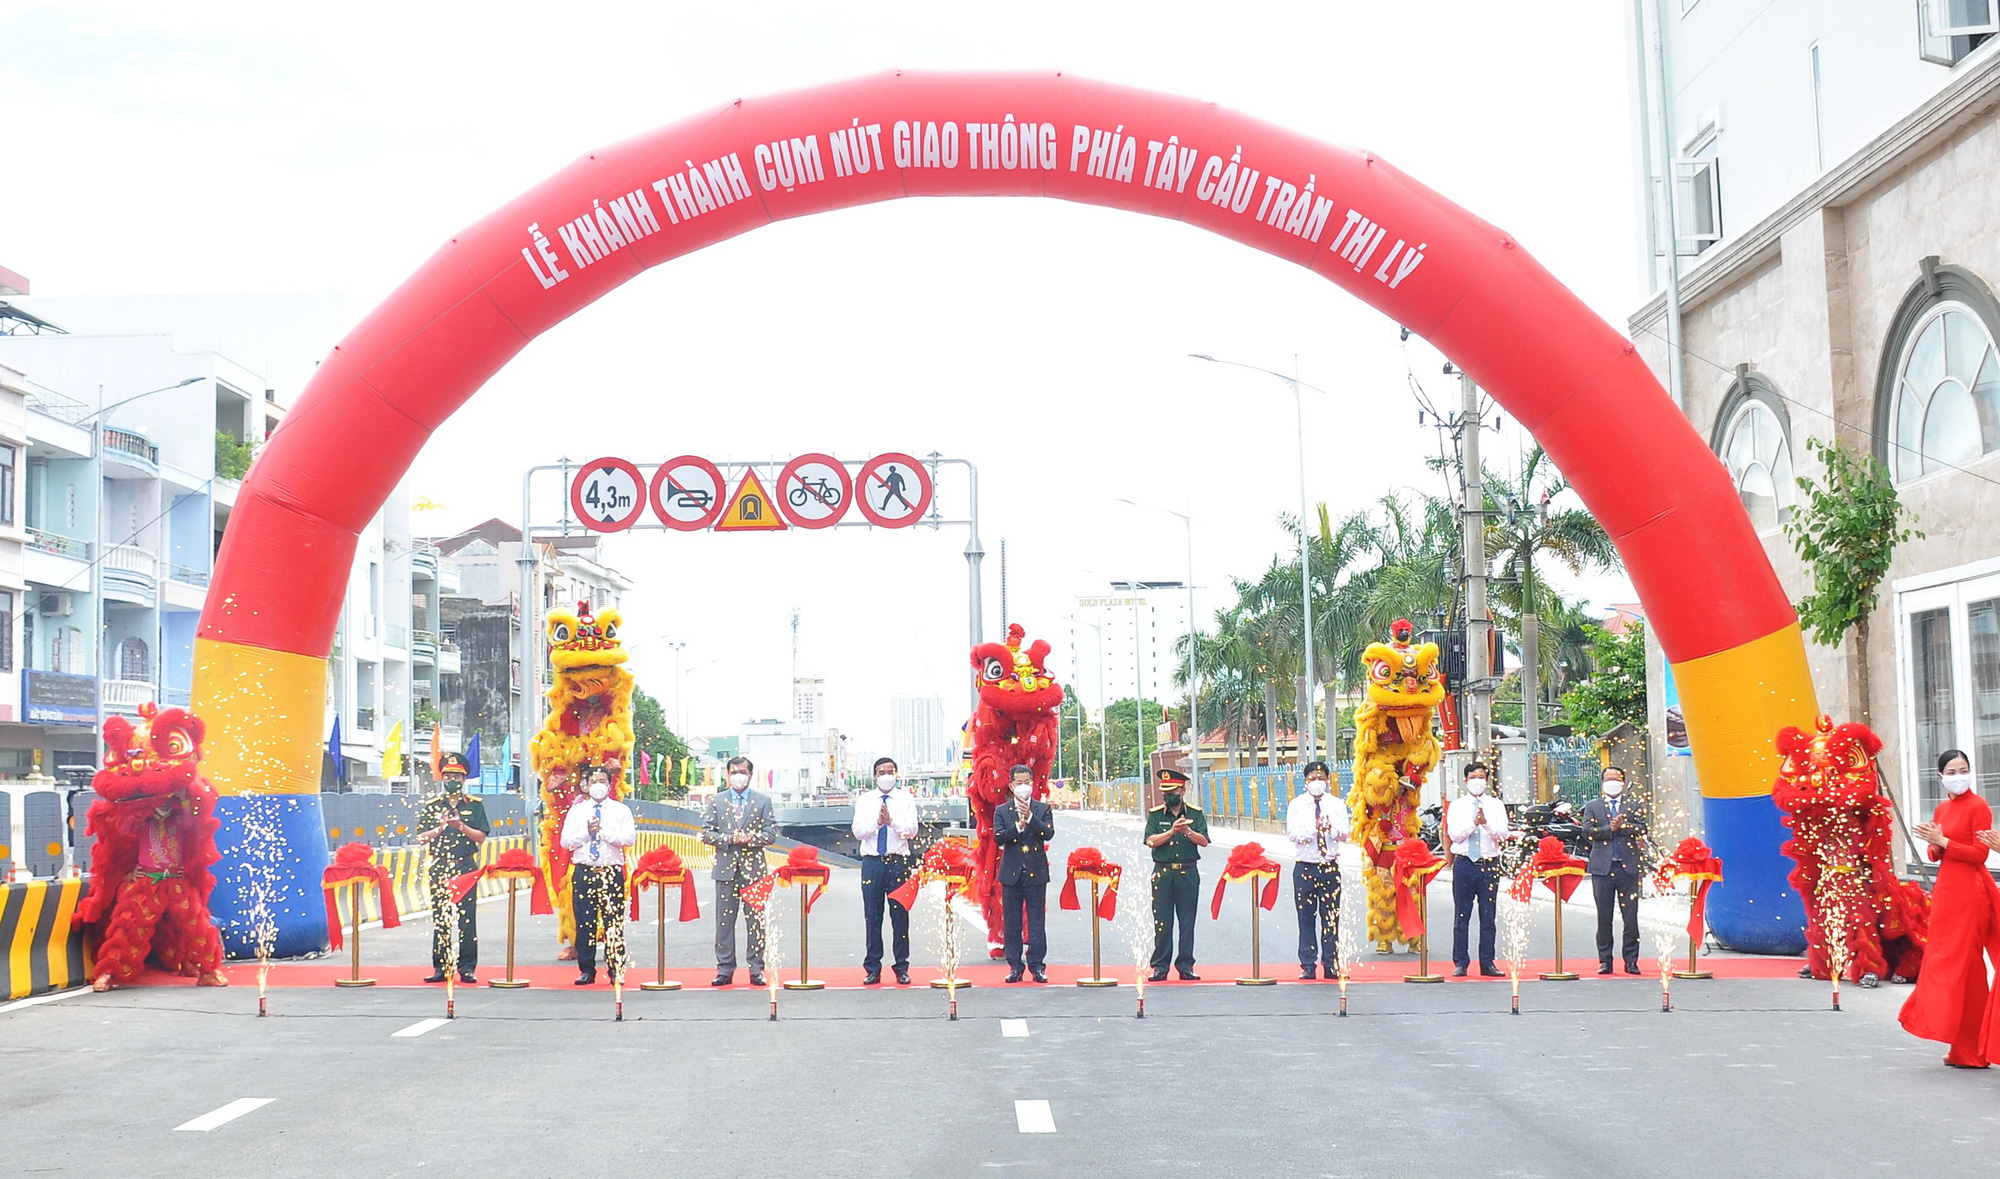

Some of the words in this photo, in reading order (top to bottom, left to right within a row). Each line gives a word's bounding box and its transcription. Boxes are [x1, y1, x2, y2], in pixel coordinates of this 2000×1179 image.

[521, 222, 570, 290] LỄ
[557, 198, 661, 269] KHÁNH
[652, 159, 752, 224] THÀNH
[754, 135, 825, 193] CỤM
[829, 117, 884, 178] NÚT
[893, 120, 959, 169] GIAO
[965, 113, 1057, 170] THÔNG
[1069, 124, 1136, 184] PHÍA
[1143, 135, 1199, 194] TÂY
[1196, 145, 1260, 215] CẦU
[1255, 174, 1335, 244] TRẦN
[1329, 208, 1387, 274] THỊ
[1374, 238, 1428, 290] LÝ
[1079, 598, 1099, 607] GOLD
[1099, 598, 1123, 606] PLAZA
